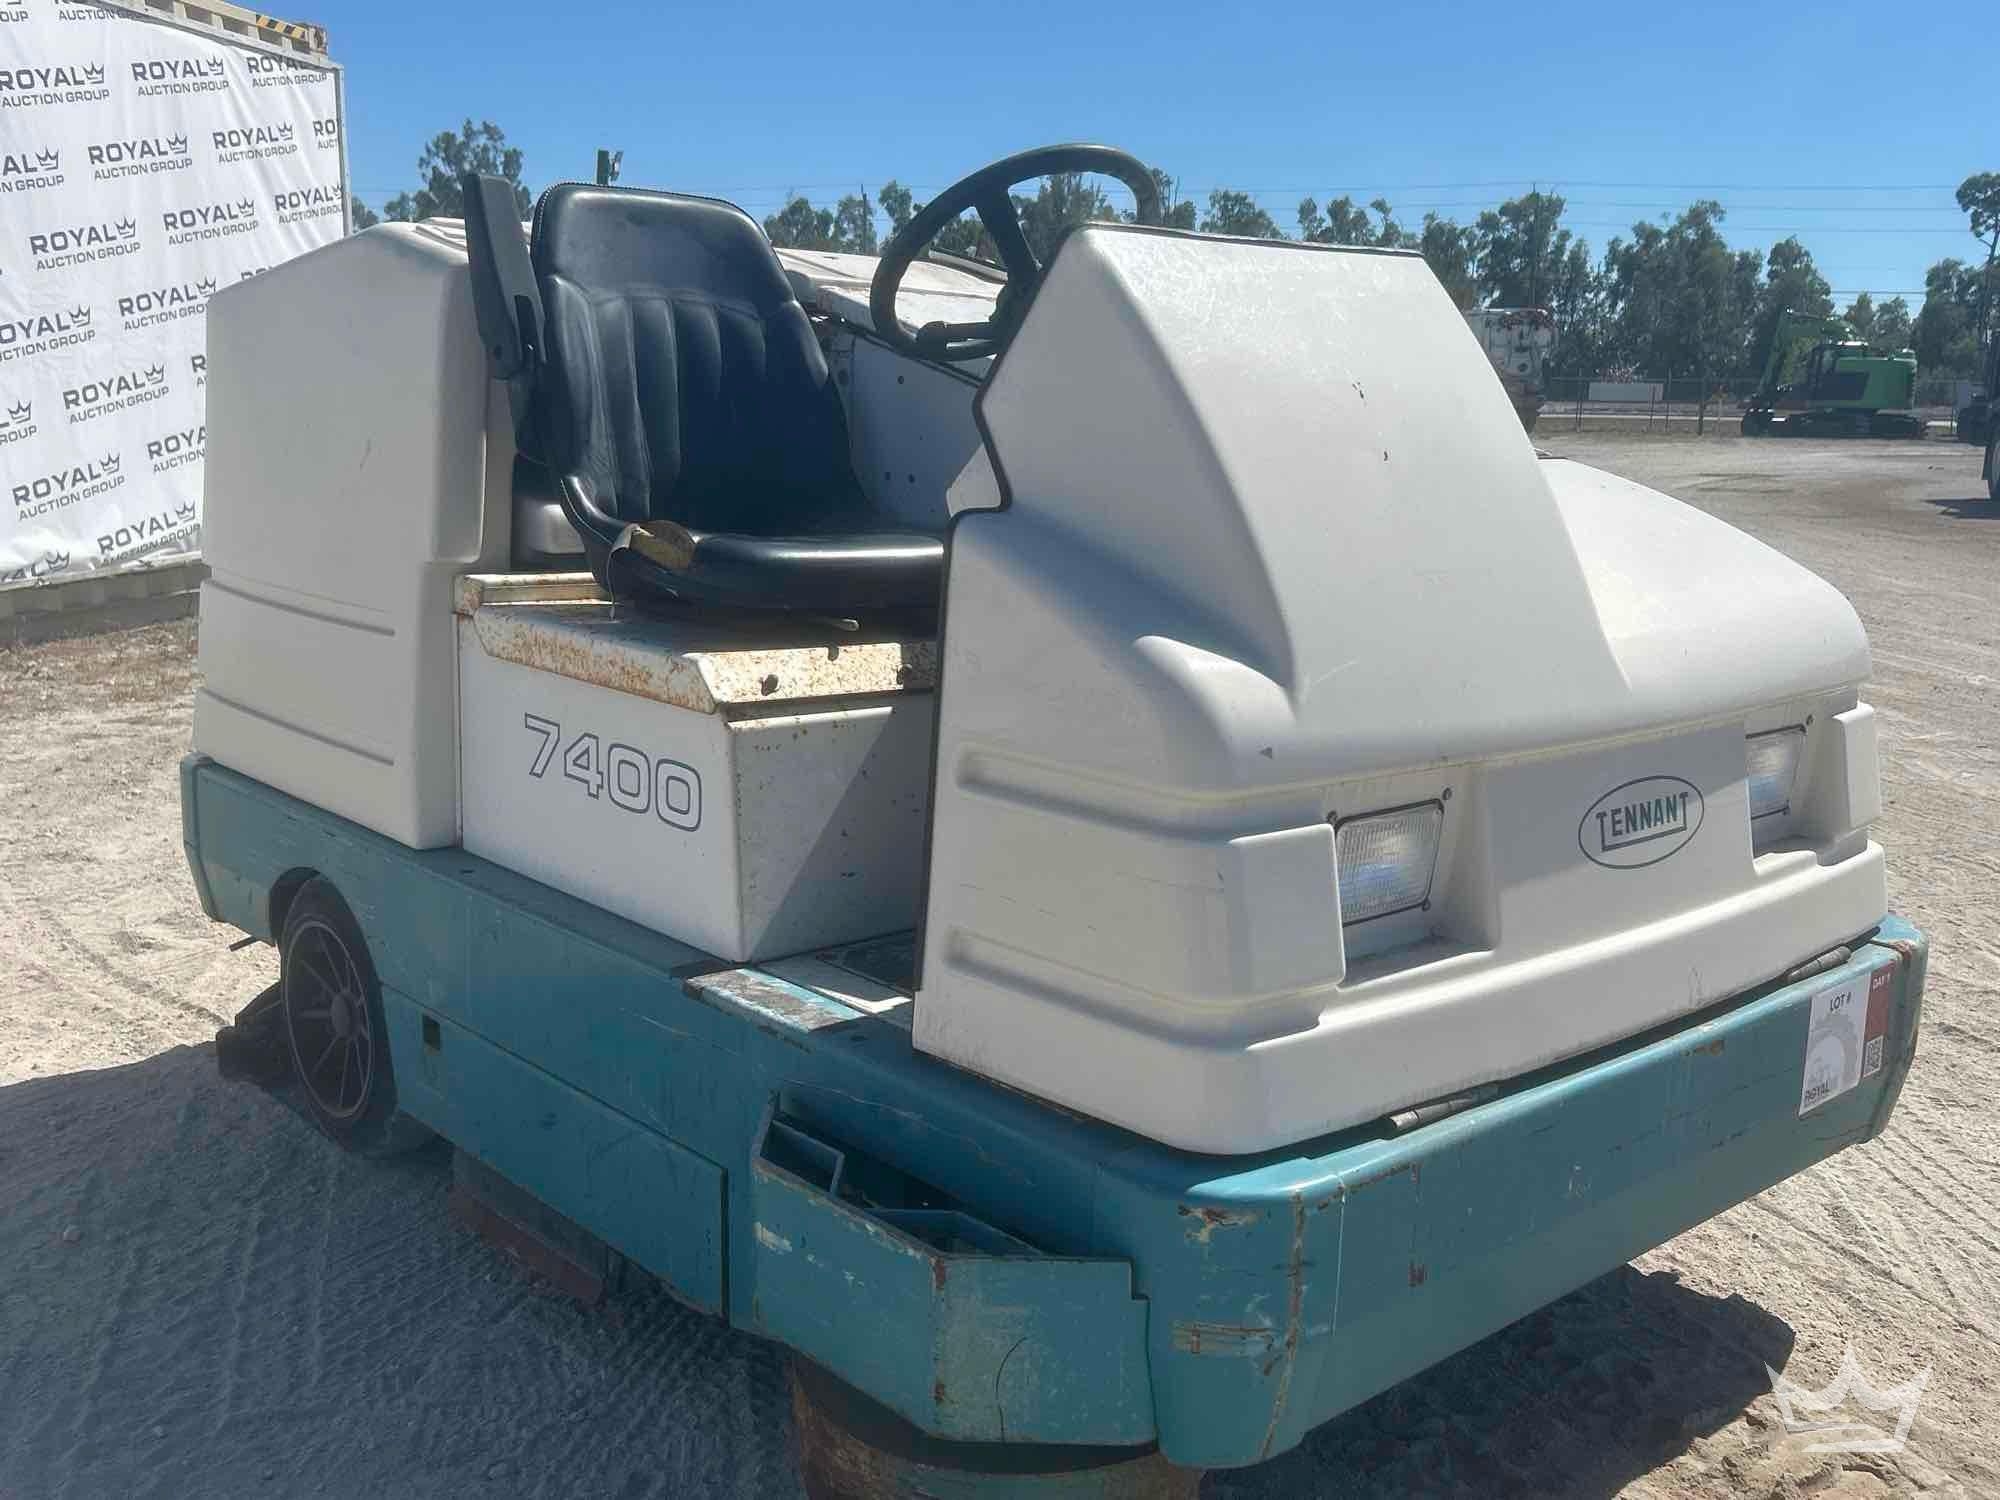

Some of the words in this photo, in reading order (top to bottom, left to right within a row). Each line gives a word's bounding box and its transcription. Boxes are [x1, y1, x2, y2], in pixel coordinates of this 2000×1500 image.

[0, 11, 29, 22] OUP
[59, 8, 117, 21] AUCTION
[131, 60, 208, 81] ROYAL
[246, 55, 299, 73] ROYA
[0, 66, 85, 91] ROYAL
[138, 83, 191, 96] AUCTION
[192, 80, 229, 93] GROUP
[252, 76, 293, 88] AUCTION
[294, 73, 327, 84] GROUP
[2, 93, 64, 108] AUCTION
[65, 89, 110, 103] GROUP
[213, 126, 279, 149] ROYAL
[88, 138, 169, 165] ROYAL
[219, 149, 263, 163] AUCTION
[264, 144, 297, 157] GROUP
[94, 163, 148, 181] AUCTION
[150, 158, 193, 173] GROUP
[15, 175, 65, 191] GROUP
[274, 186, 334, 211] ROYAL
[163, 203, 239, 231] ROYAL
[279, 206, 319, 224] AUCTION
[29, 223, 117, 255] ROYAL
[168, 228, 221, 246] AUCTION
[222, 220, 259, 236] GROUP
[37, 251, 96, 272] AUCTION
[97, 242, 141, 260] GROUP
[118, 284, 198, 317] ROYAL
[0, 313, 71, 344] OYAL
[123, 310, 177, 331] AUCTION
[178, 303, 206, 319] GRO
[0, 341, 47, 362] CTION
[49, 329, 96, 350] GROUP
[63, 372, 146, 409] ROYAL
[69, 399, 125, 425] AUCTION
[127, 386, 169, 407] GROUP
[0, 425, 37, 445] ROUP
[147, 426, 206, 460] ROYA
[153, 448, 205, 474] AUCTION
[12, 463, 101, 506] ROYAL
[19, 491, 80, 521] AUCTION
[82, 475, 125, 499] GROUP
[97, 512, 177, 555] ROYAL
[524, 712, 702, 832] 7400
[1596, 791, 1688, 853] TENNANT
